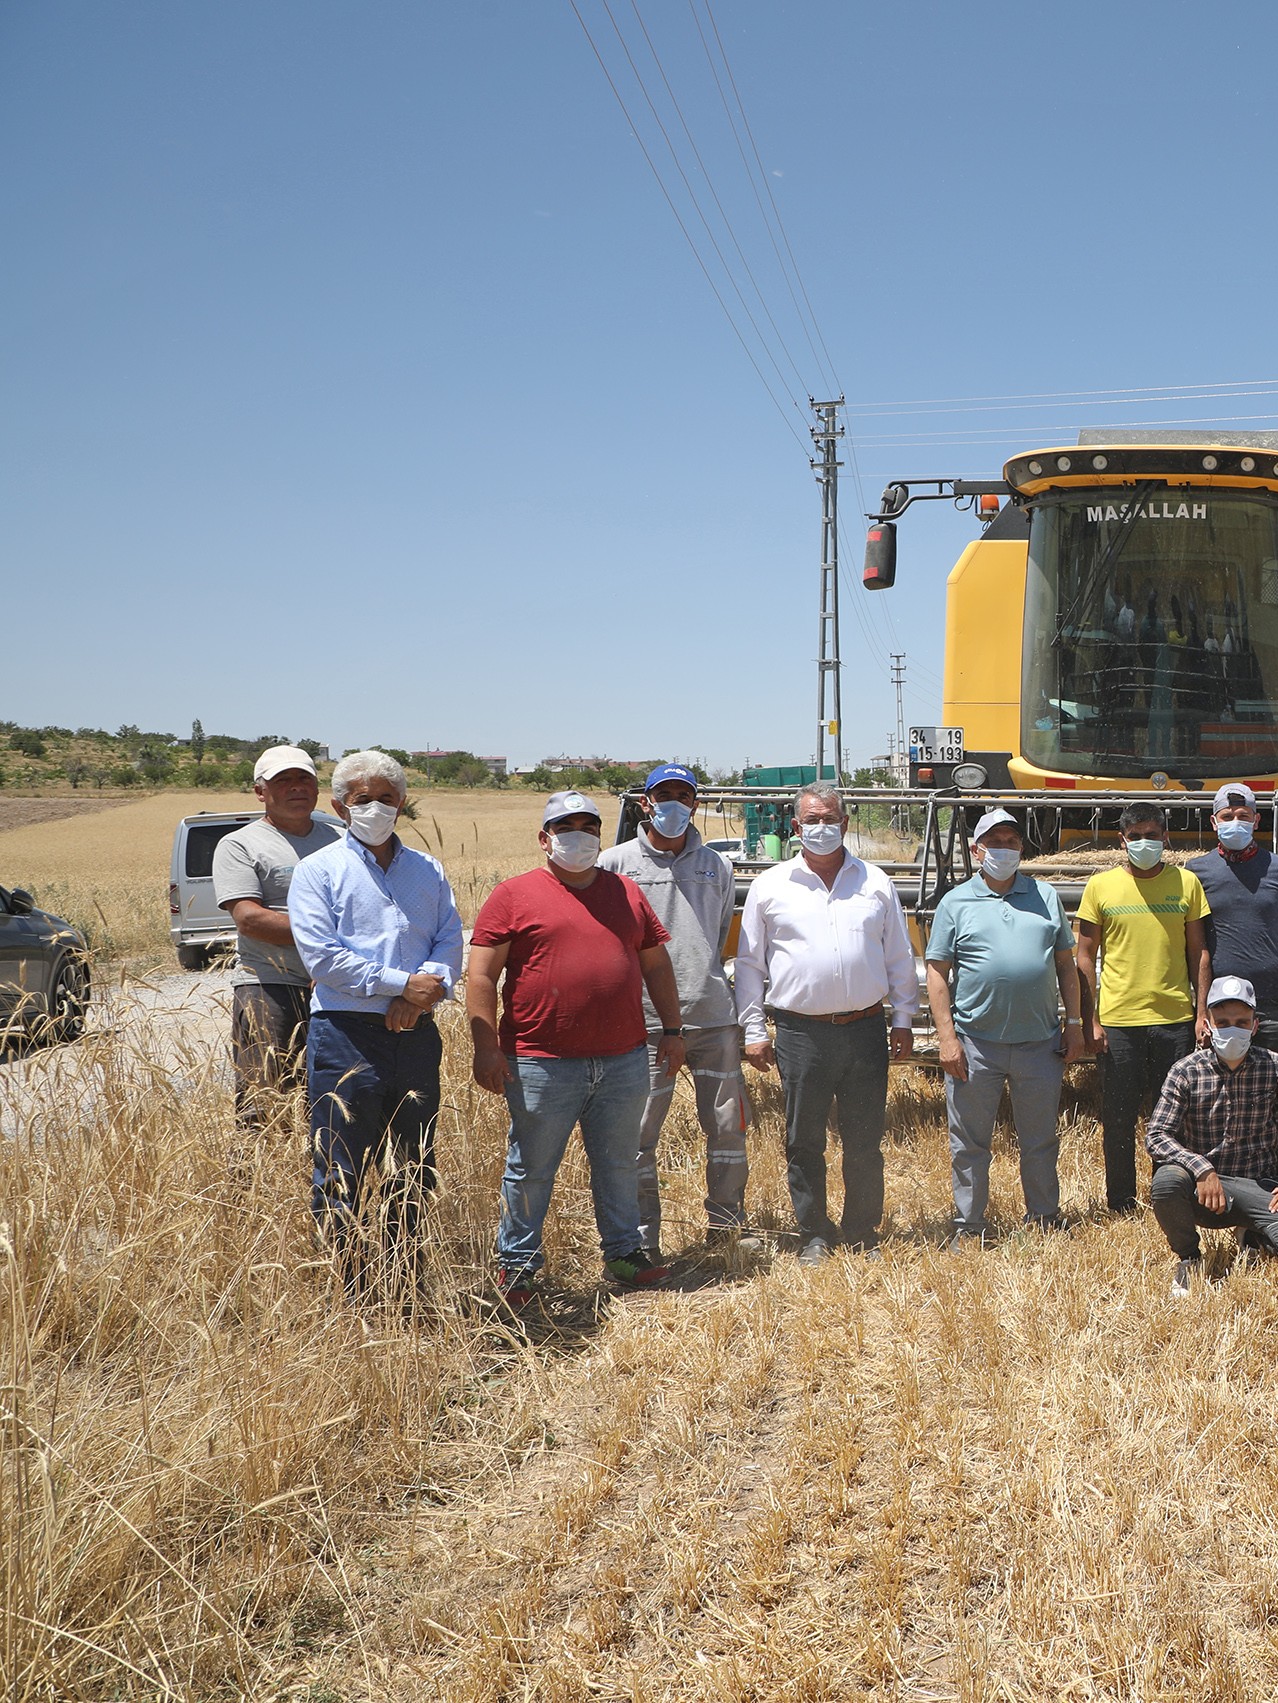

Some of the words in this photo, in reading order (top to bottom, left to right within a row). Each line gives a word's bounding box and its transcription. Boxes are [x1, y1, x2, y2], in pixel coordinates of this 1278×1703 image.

[911, 729, 926, 744] 34
[947, 730, 962, 744] 19
[918, 746, 962, 761] 15-193
